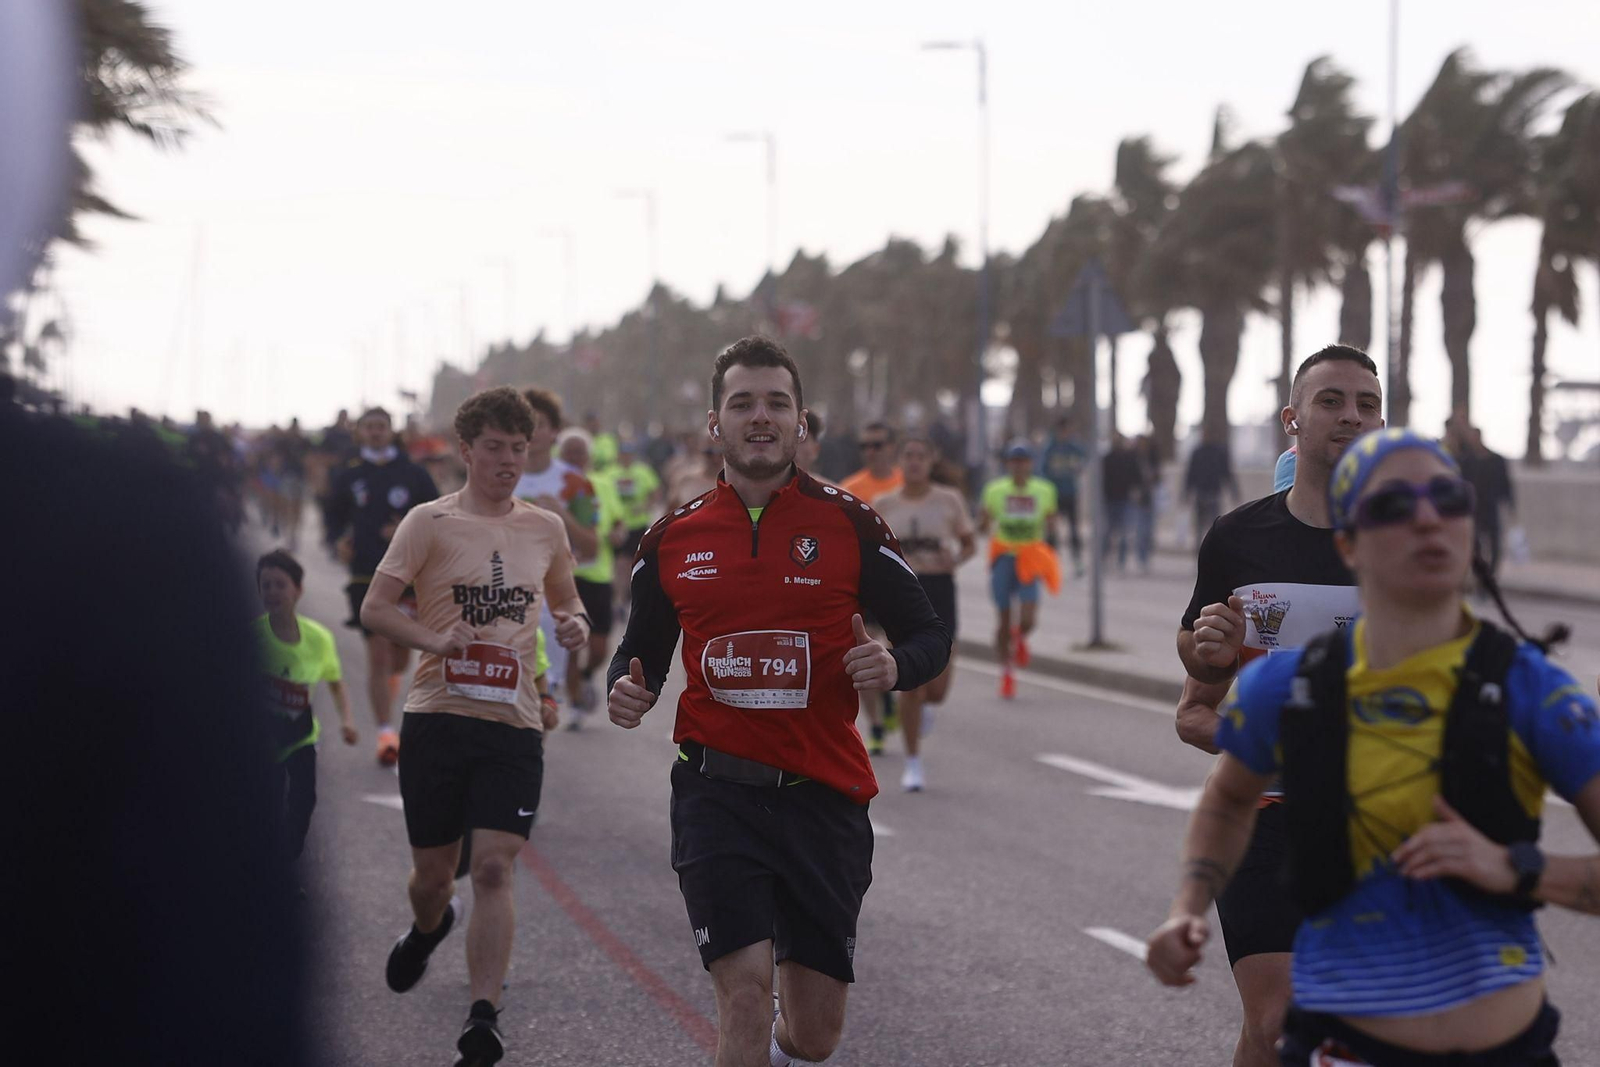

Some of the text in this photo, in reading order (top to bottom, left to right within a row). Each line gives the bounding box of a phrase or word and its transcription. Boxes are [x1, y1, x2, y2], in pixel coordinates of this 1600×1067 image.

[684, 551, 714, 564] JAKO
[794, 577, 821, 586] Metzger
[451, 584, 534, 607] BRUNCH
[462, 604, 500, 628] RUN
[708, 657, 751, 669] BRUNCH
[759, 658, 798, 676] 794
[485, 664, 513, 679] 877
[713, 667, 733, 679] RUN
[694, 926, 711, 947] DM
